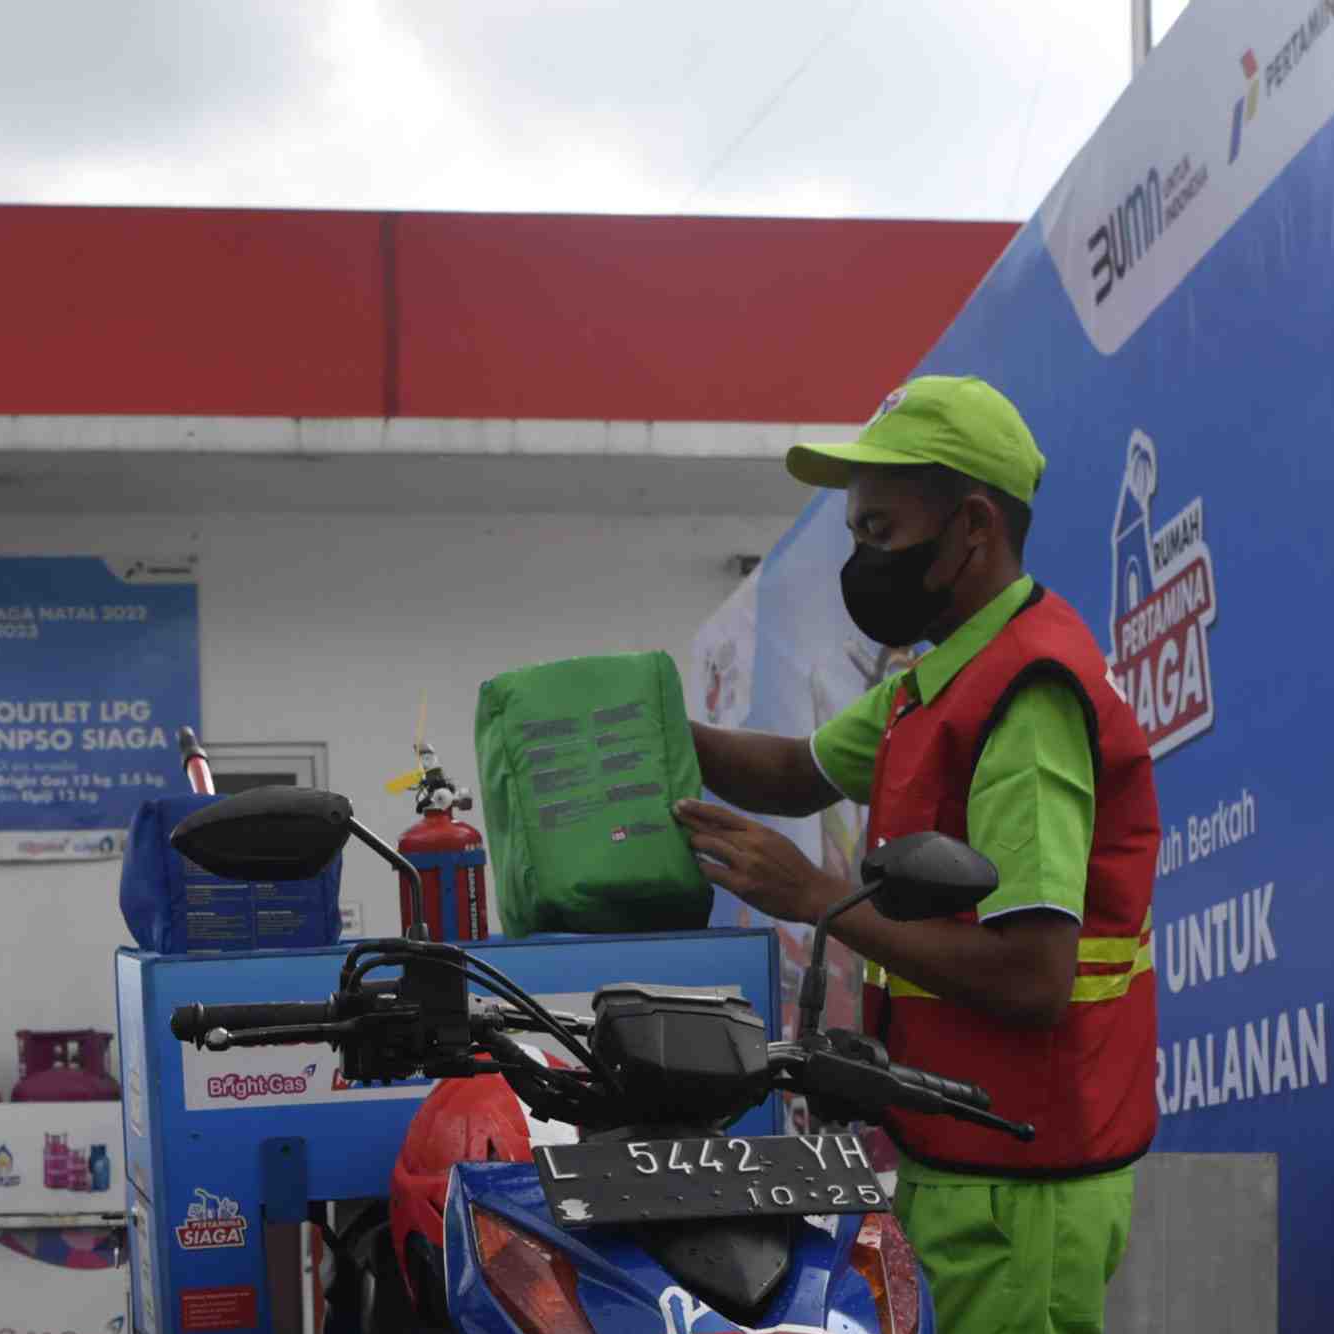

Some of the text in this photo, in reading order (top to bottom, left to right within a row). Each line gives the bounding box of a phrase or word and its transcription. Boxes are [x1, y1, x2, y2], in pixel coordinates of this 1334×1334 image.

[1153, 508, 1200, 573] RUMAH
[1122, 565, 1206, 662] PERTAMINA
[100, 701, 151, 722] LPG
[82, 727, 168, 750] SIAGA
[1188, 788, 1255, 863] Berkah
[1167, 882, 1276, 993] UNTUK
[208, 1074, 267, 1099] Bright
[269, 1074, 307, 1095] Gas
[543, 1136, 870, 1179] L 5442 YH
[184, 1229, 240, 1246] SIAGA
